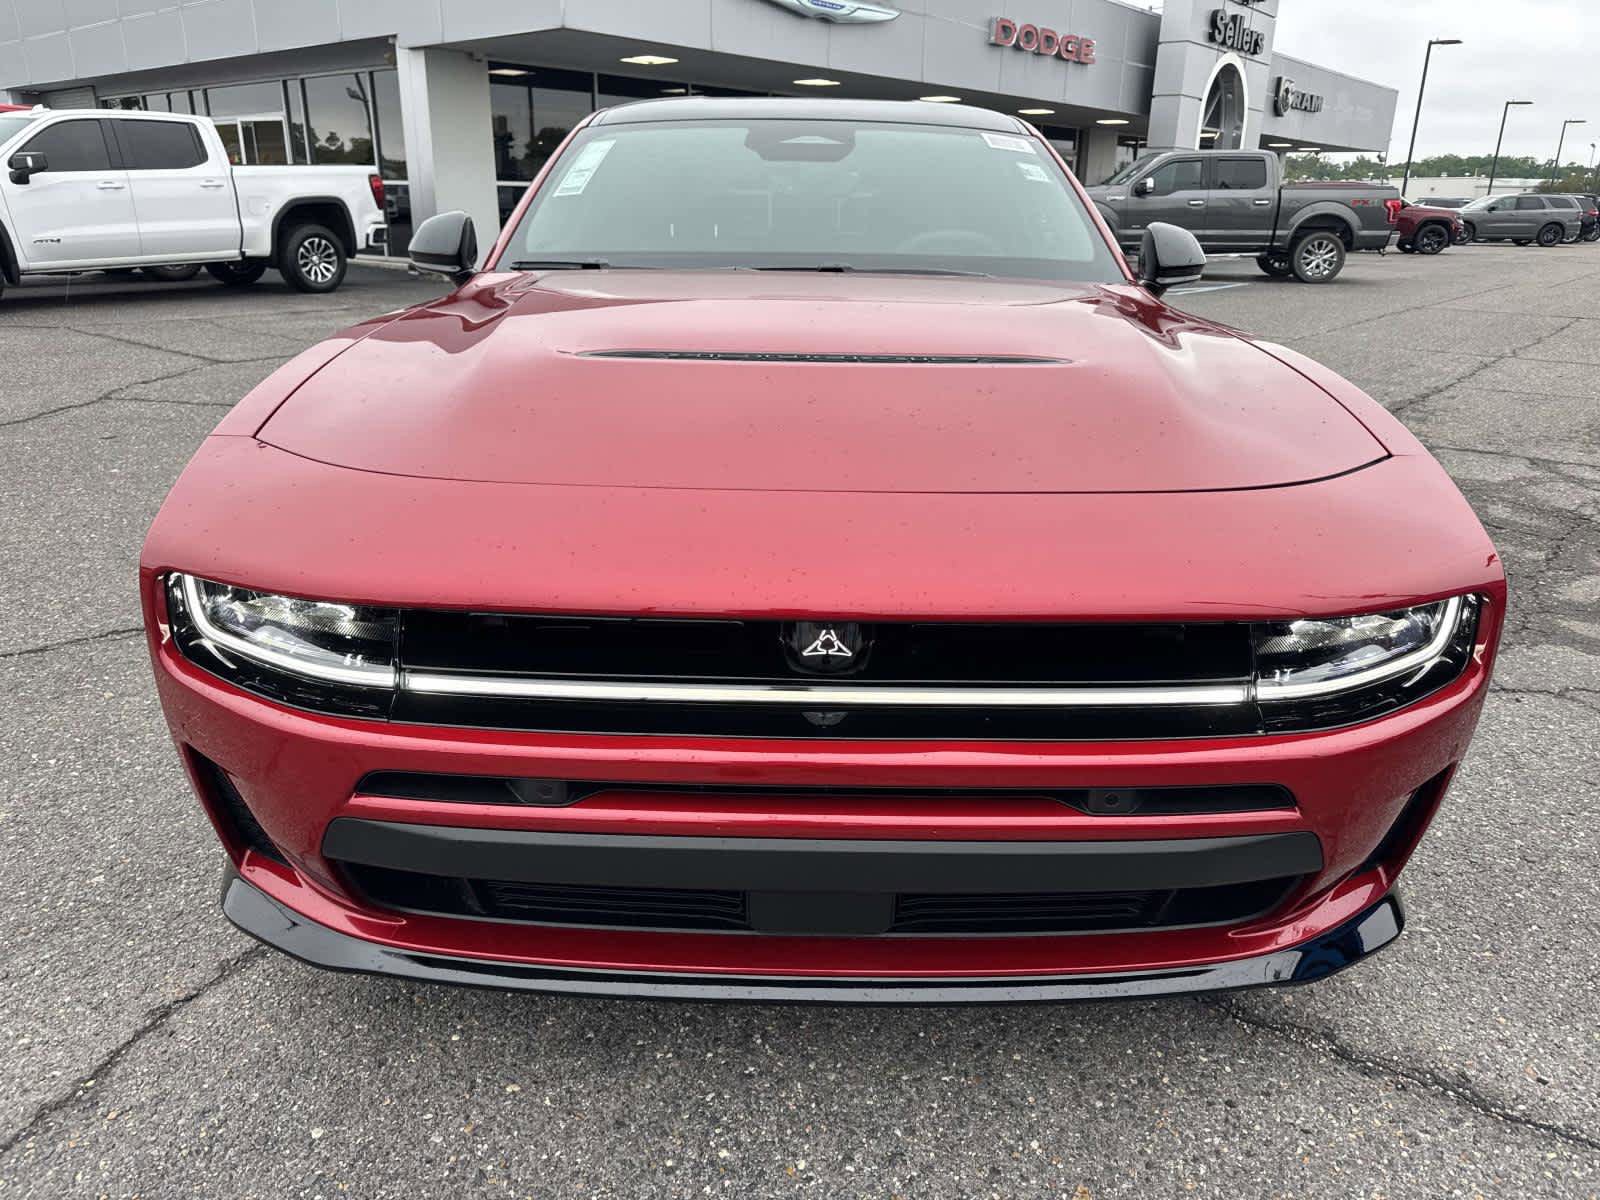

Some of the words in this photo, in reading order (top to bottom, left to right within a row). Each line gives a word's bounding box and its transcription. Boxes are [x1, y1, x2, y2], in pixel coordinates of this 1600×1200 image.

[989, 17, 1096, 64] DODGE
[1209, 9, 1265, 55] Sellers
[1291, 91, 1324, 112] RAM
